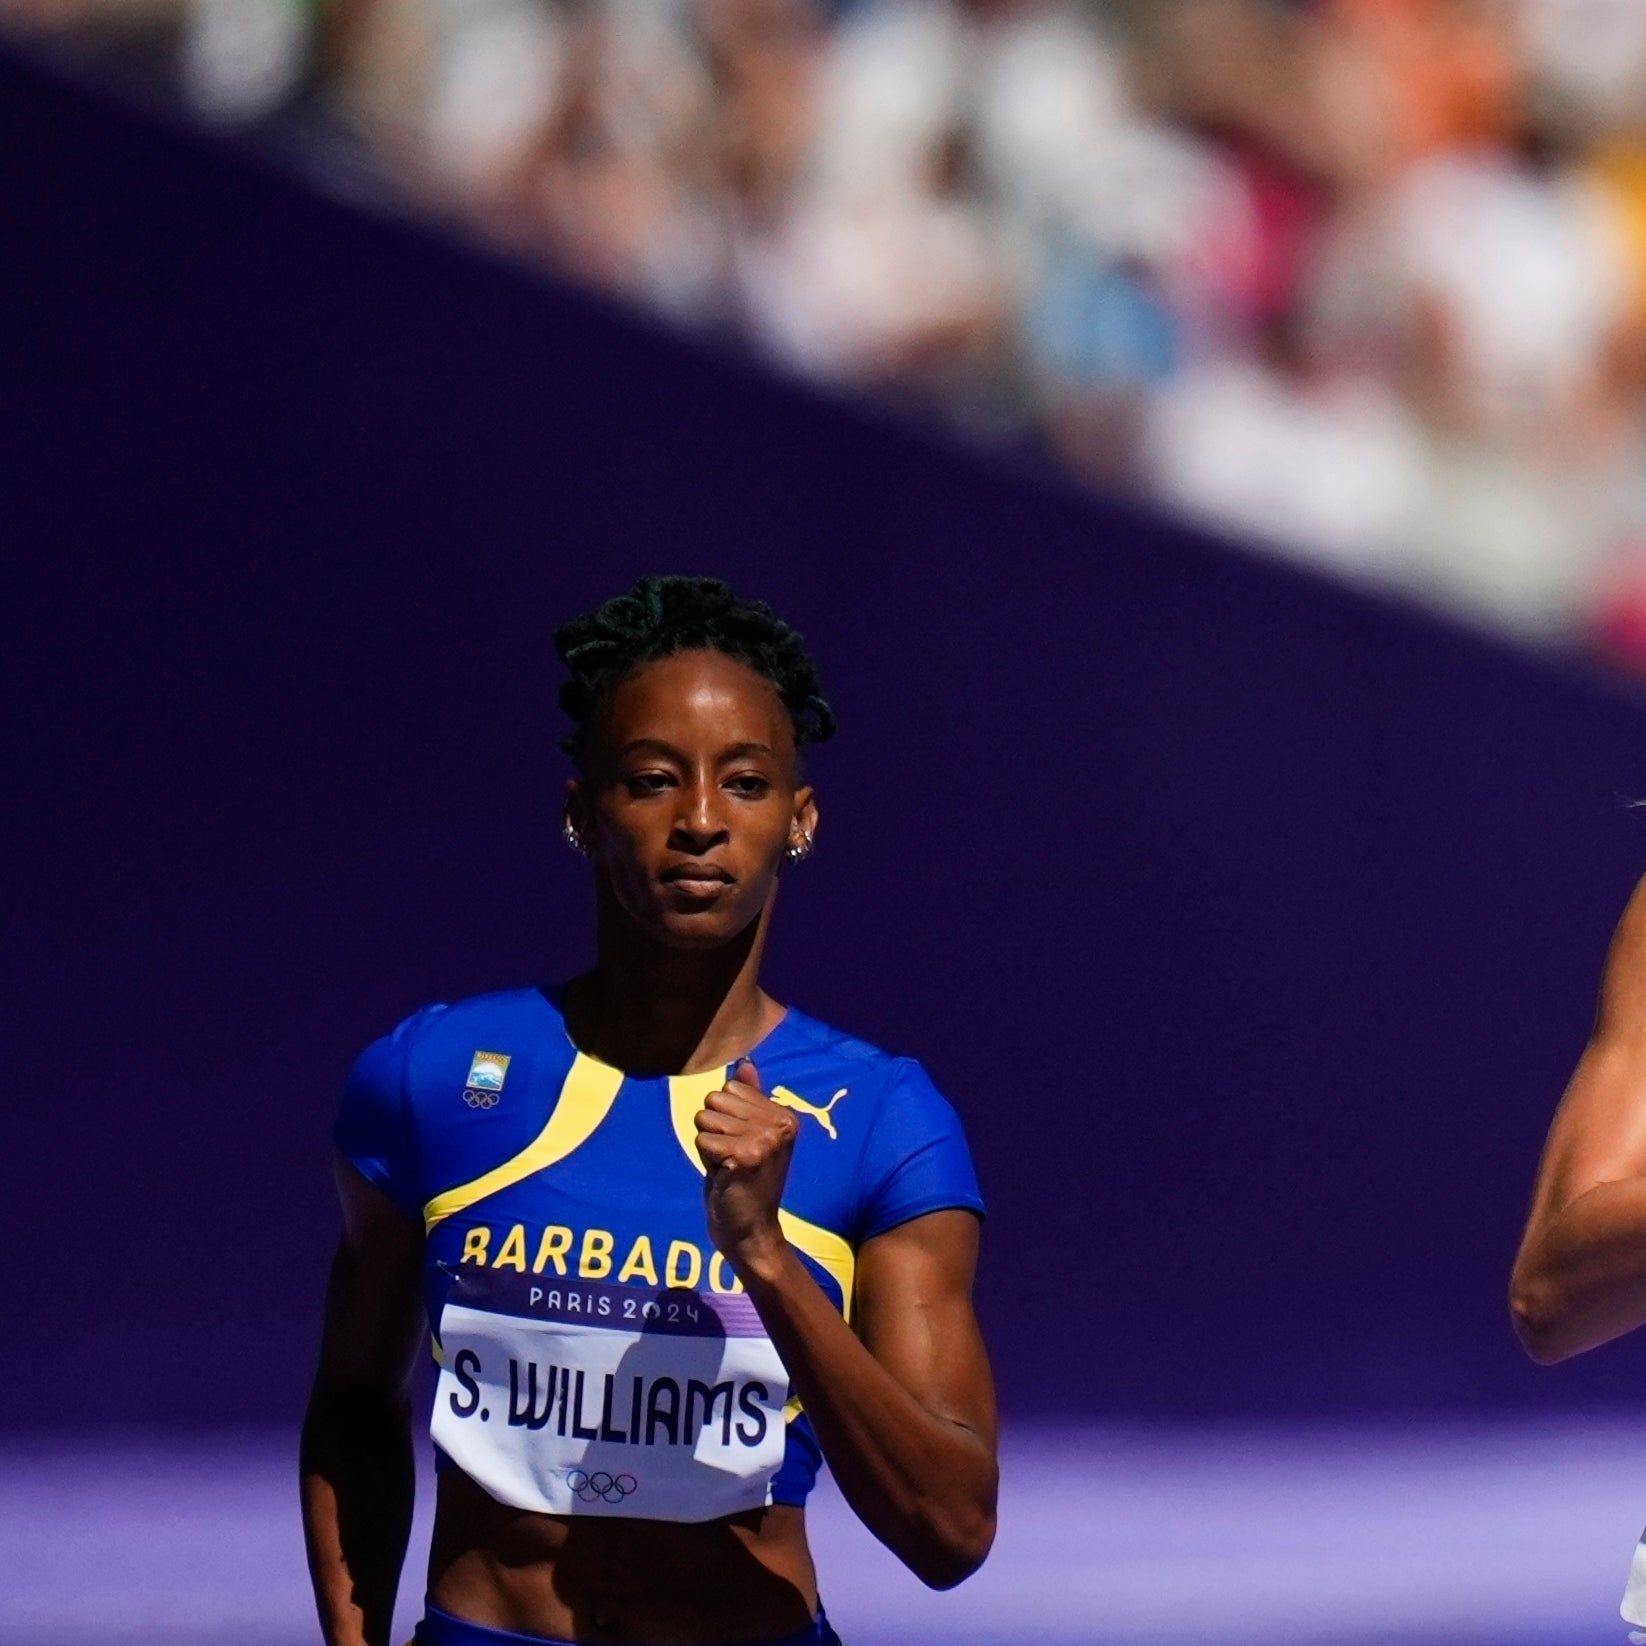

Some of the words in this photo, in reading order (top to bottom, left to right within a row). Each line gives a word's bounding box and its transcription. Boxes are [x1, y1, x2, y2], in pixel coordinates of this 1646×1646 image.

[460, 1223, 745, 1294] BARBADO
[529, 1287, 612, 1316] PARIS
[623, 1299, 699, 1323] 2024
[449, 1349, 490, 1422] S.
[508, 1359, 769, 1448] WILLIAMS
